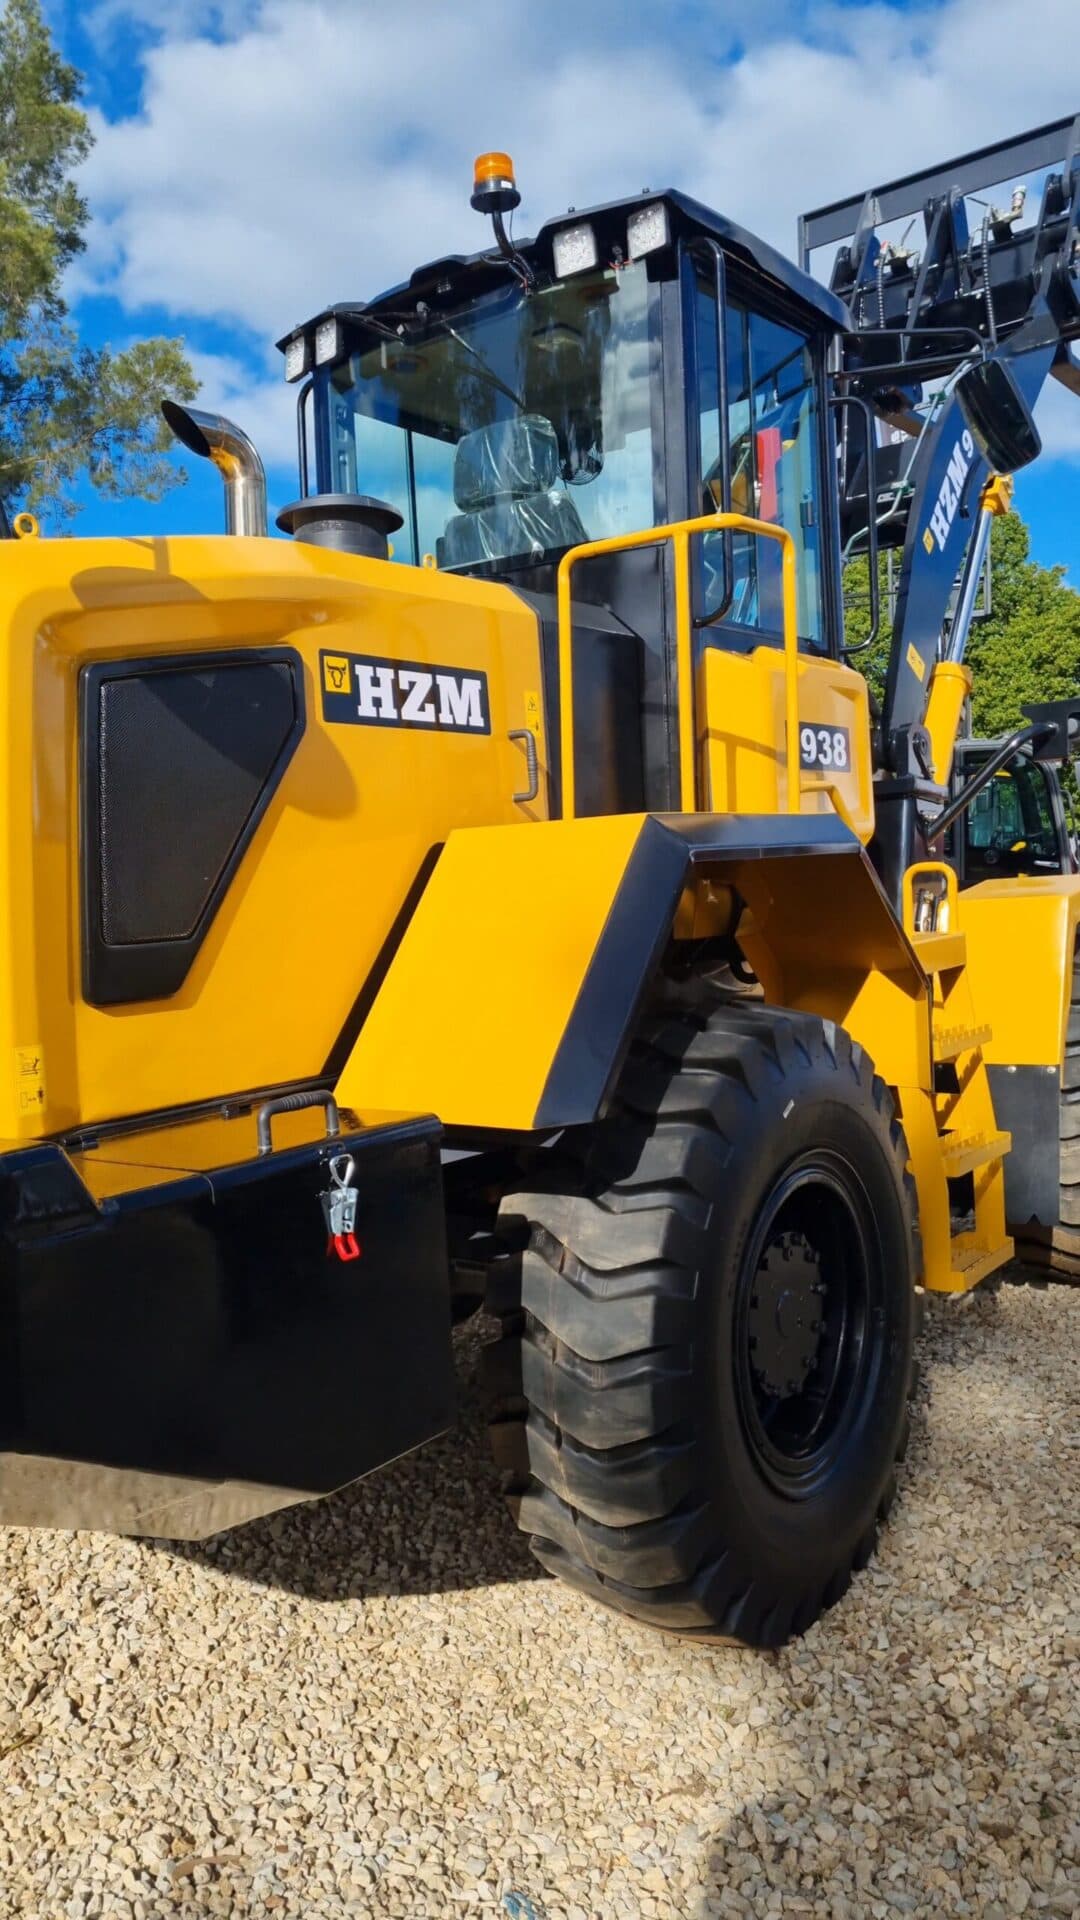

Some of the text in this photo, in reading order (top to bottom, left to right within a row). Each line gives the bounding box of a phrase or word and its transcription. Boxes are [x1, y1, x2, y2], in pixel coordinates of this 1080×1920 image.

[930, 441, 968, 552] HZM
[354, 663, 485, 728] HZM
[800, 727, 847, 767] 938
